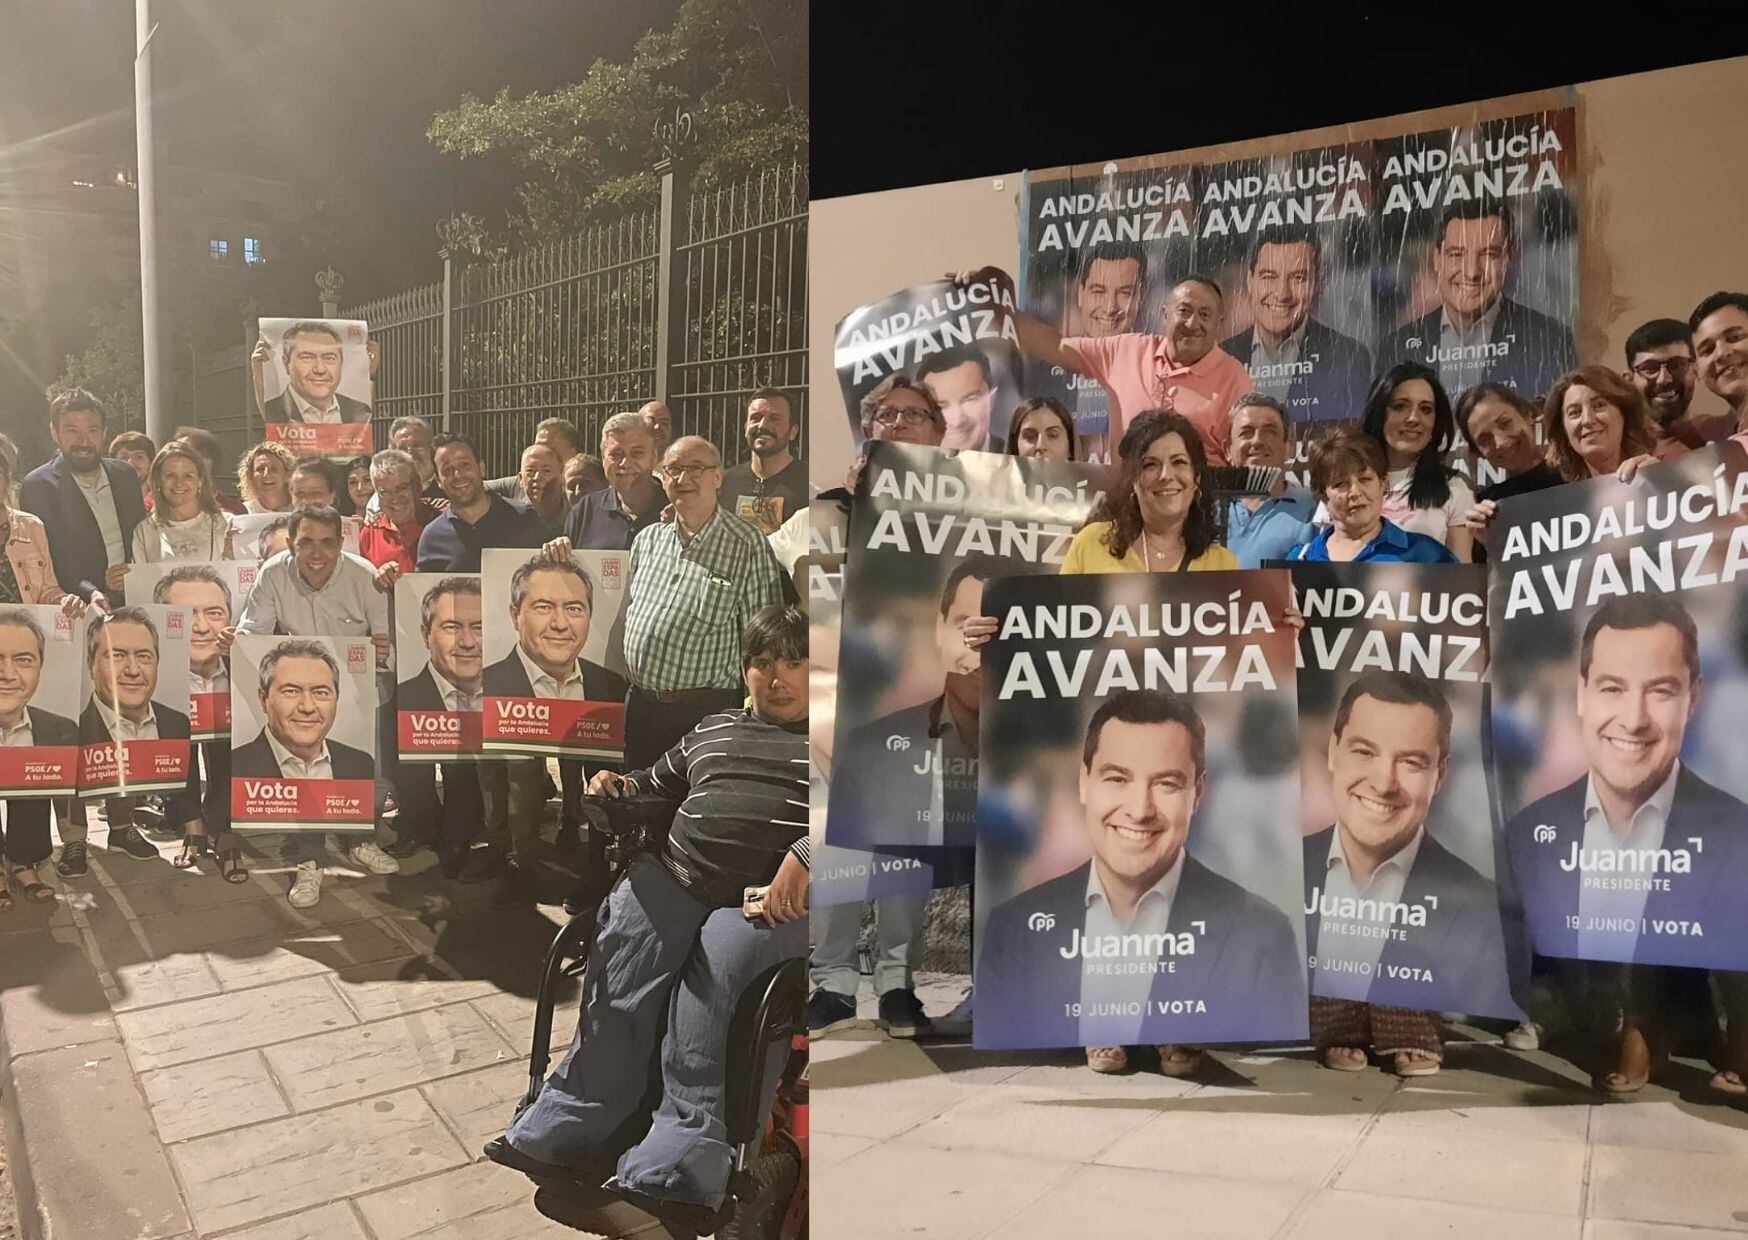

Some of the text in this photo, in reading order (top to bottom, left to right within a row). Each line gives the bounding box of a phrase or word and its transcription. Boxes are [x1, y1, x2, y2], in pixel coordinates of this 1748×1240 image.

[1382, 125, 1563, 179] ANDALUCÍA
[1203, 155, 1367, 204] ANDALUCÍA
[1382, 160, 1564, 215] AVANZA
[1038, 178, 1192, 219] ANDALUCÍA
[1201, 188, 1367, 239] AVANZA
[1038, 209, 1190, 252] AVANZA
[849, 277, 1017, 347] ANDALUCÍA
[852, 309, 1021, 386] AVANZA
[1425, 340, 1510, 363] Juanma
[1292, 397, 1320, 407] VOTA
[276, 426, 317, 439] Vota
[1501, 463, 1748, 563] ANDALUCÍA
[1503, 525, 1748, 620] AVANZA
[998, 589, 1276, 641] ANDALUCÍA
[1292, 584, 1490, 627] NDALUC
[998, 644, 1278, 700] AVANZA
[496, 700, 550, 720] Vota
[410, 714, 461, 731] Vota
[498, 726, 516, 734] que
[413, 738, 429, 746] que
[83, 746, 130, 766] Vota
[244, 781, 298, 799] Vota
[246, 805, 300, 815] que quieres.
[916, 810, 931, 822] 19
[1559, 841, 1692, 874] Juanma
[819, 864, 867, 882] JUNIO
[881, 858, 922, 873] VOTA
[1584, 878, 1671, 892] PRESIDENTE
[1304, 886, 1427, 927] Juanma
[1323, 921, 1407, 941] PRESIDENTE
[1565, 915, 1703, 937] 19 JUNIO VOTA
[1059, 928, 1196, 960] Juanma
[1087, 961, 1176, 975] PRESIDENTE
[1323, 959, 1371, 975] JUNIO
[1387, 964, 1433, 982] VOTA
[1064, 1000, 1207, 1017] 19 JUNIO VOTA
